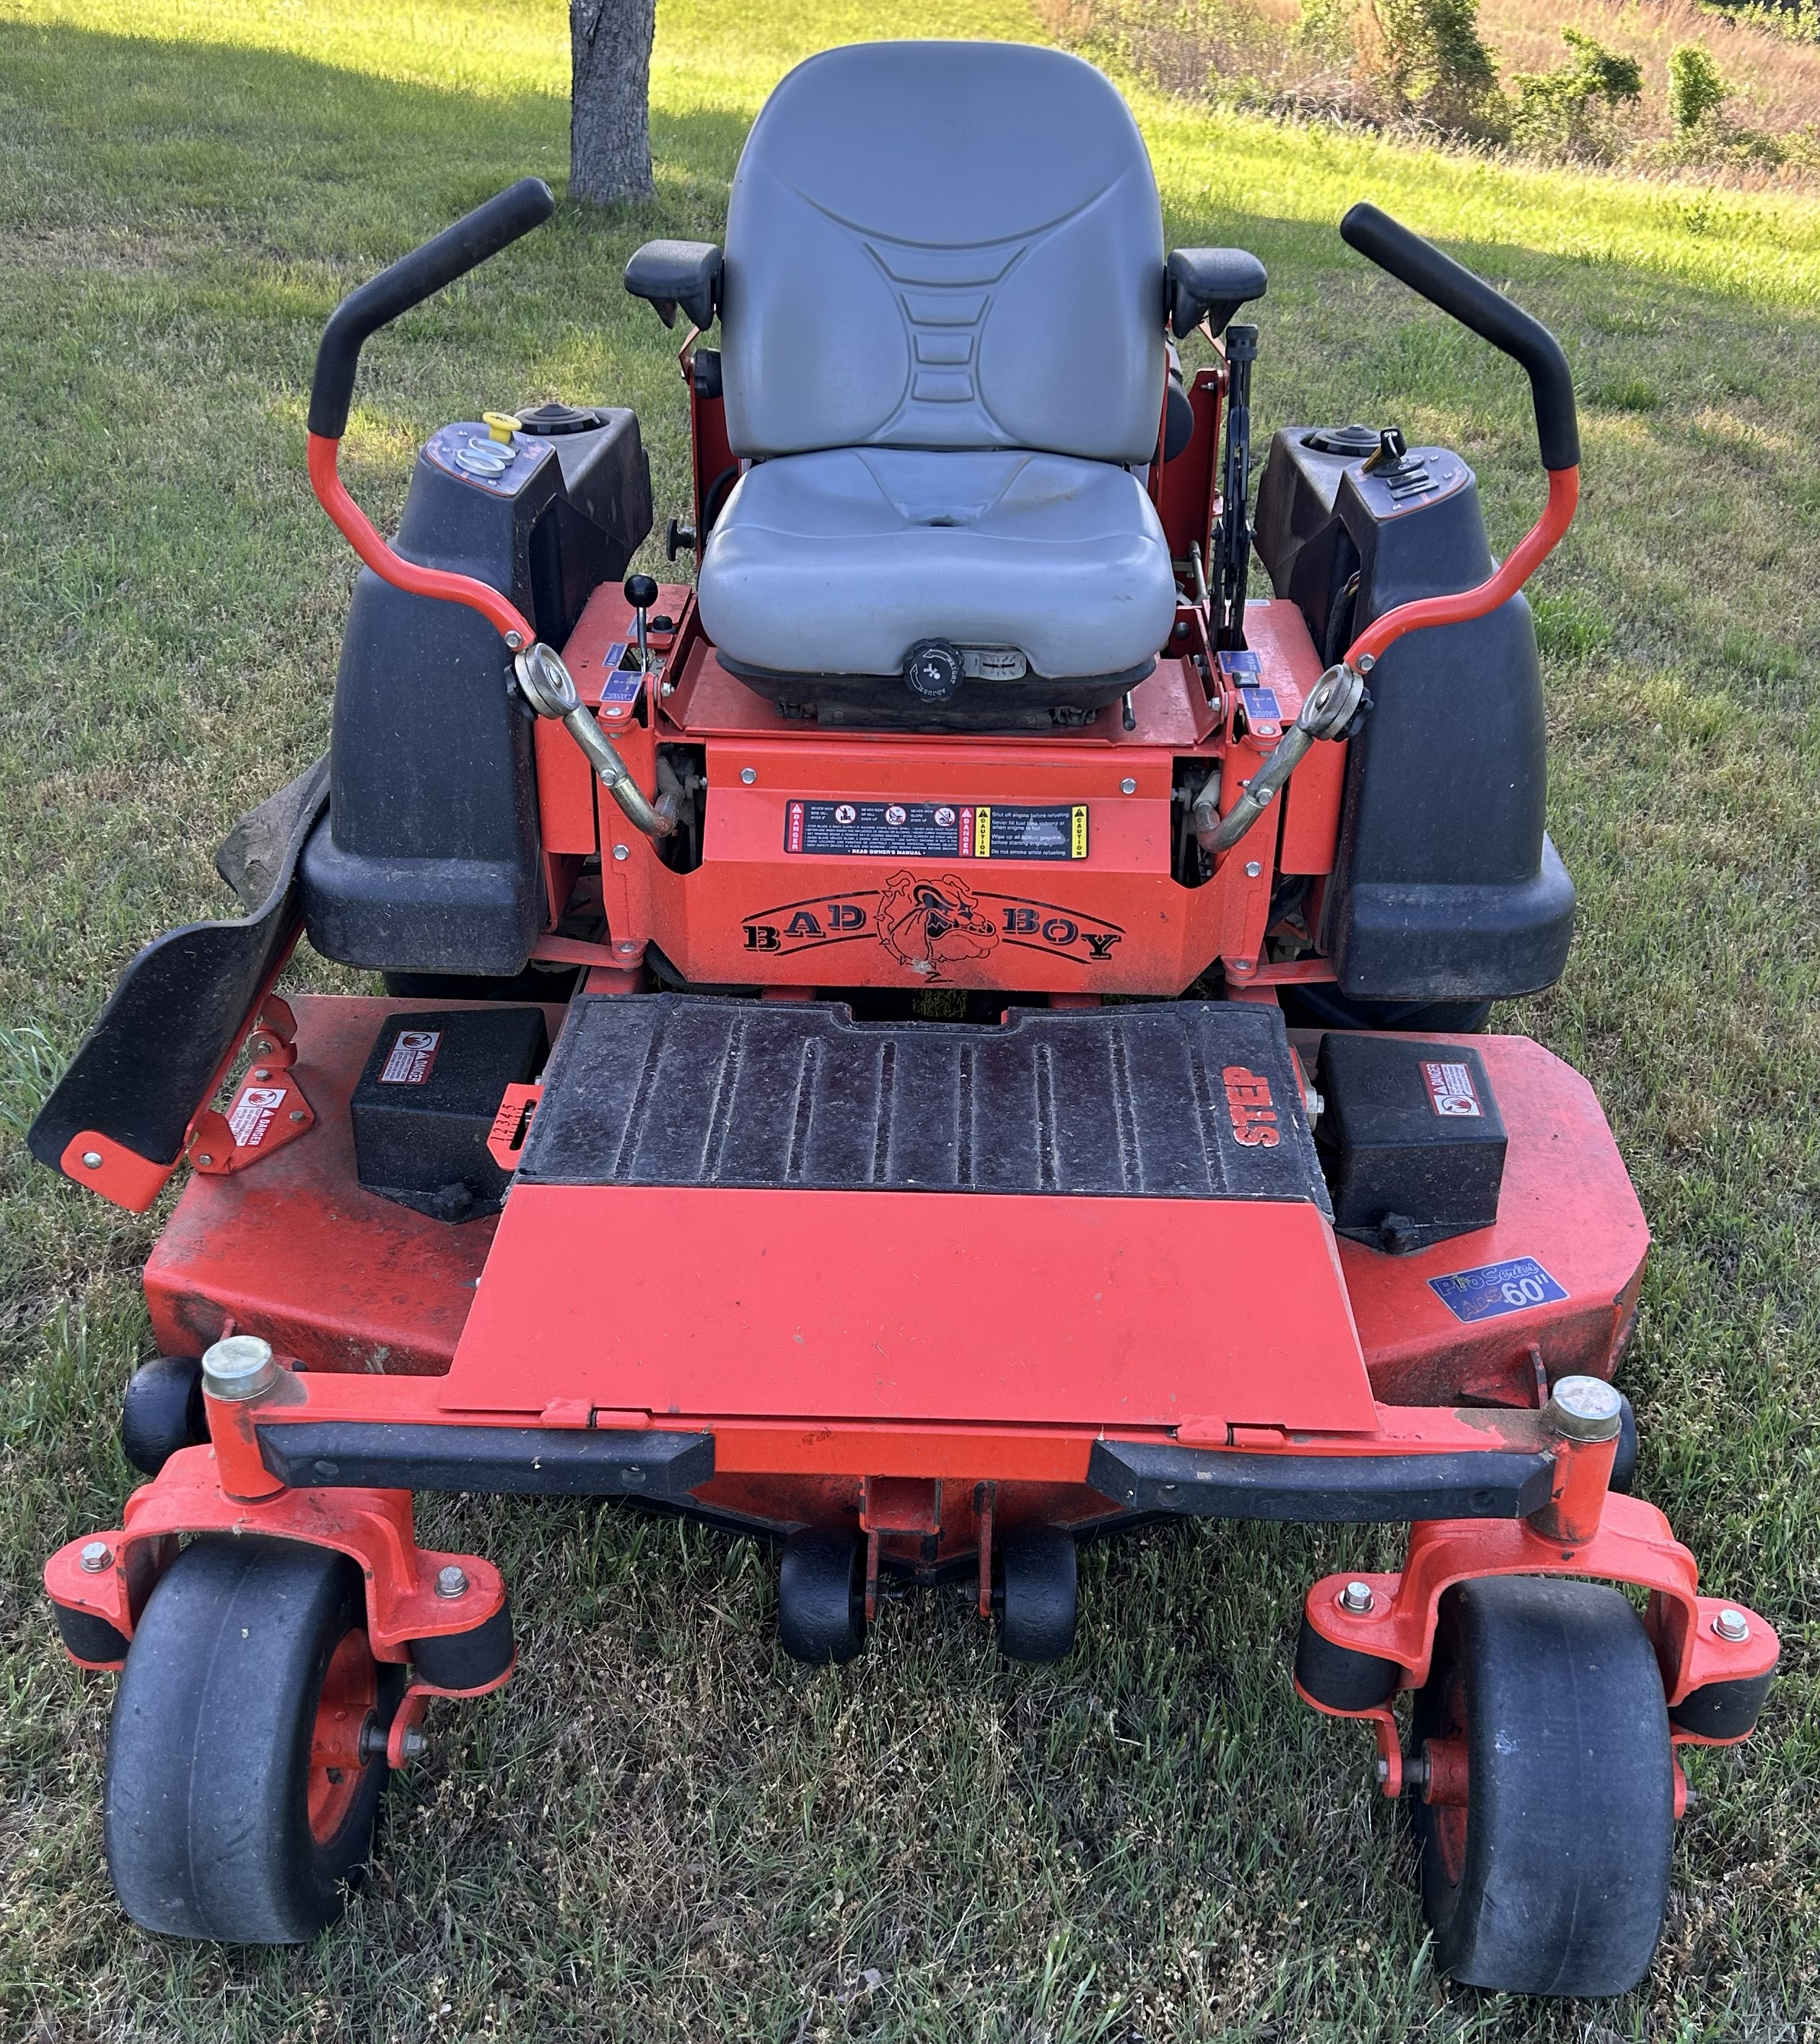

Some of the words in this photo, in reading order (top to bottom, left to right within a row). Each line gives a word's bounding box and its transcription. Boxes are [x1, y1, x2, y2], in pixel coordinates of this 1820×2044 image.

[792, 814, 800, 850] DANGER
[743, 904, 867, 952] BAD
[1003, 907, 1122, 960] BOY
[407, 1060, 428, 1082] DANGER
[1426, 1063, 1445, 1086] DANGER
[1222, 1065, 1280, 1148] STEP
[248, 1119, 271, 1146] DANGER
[1501, 1273, 1549, 1307] 60"
